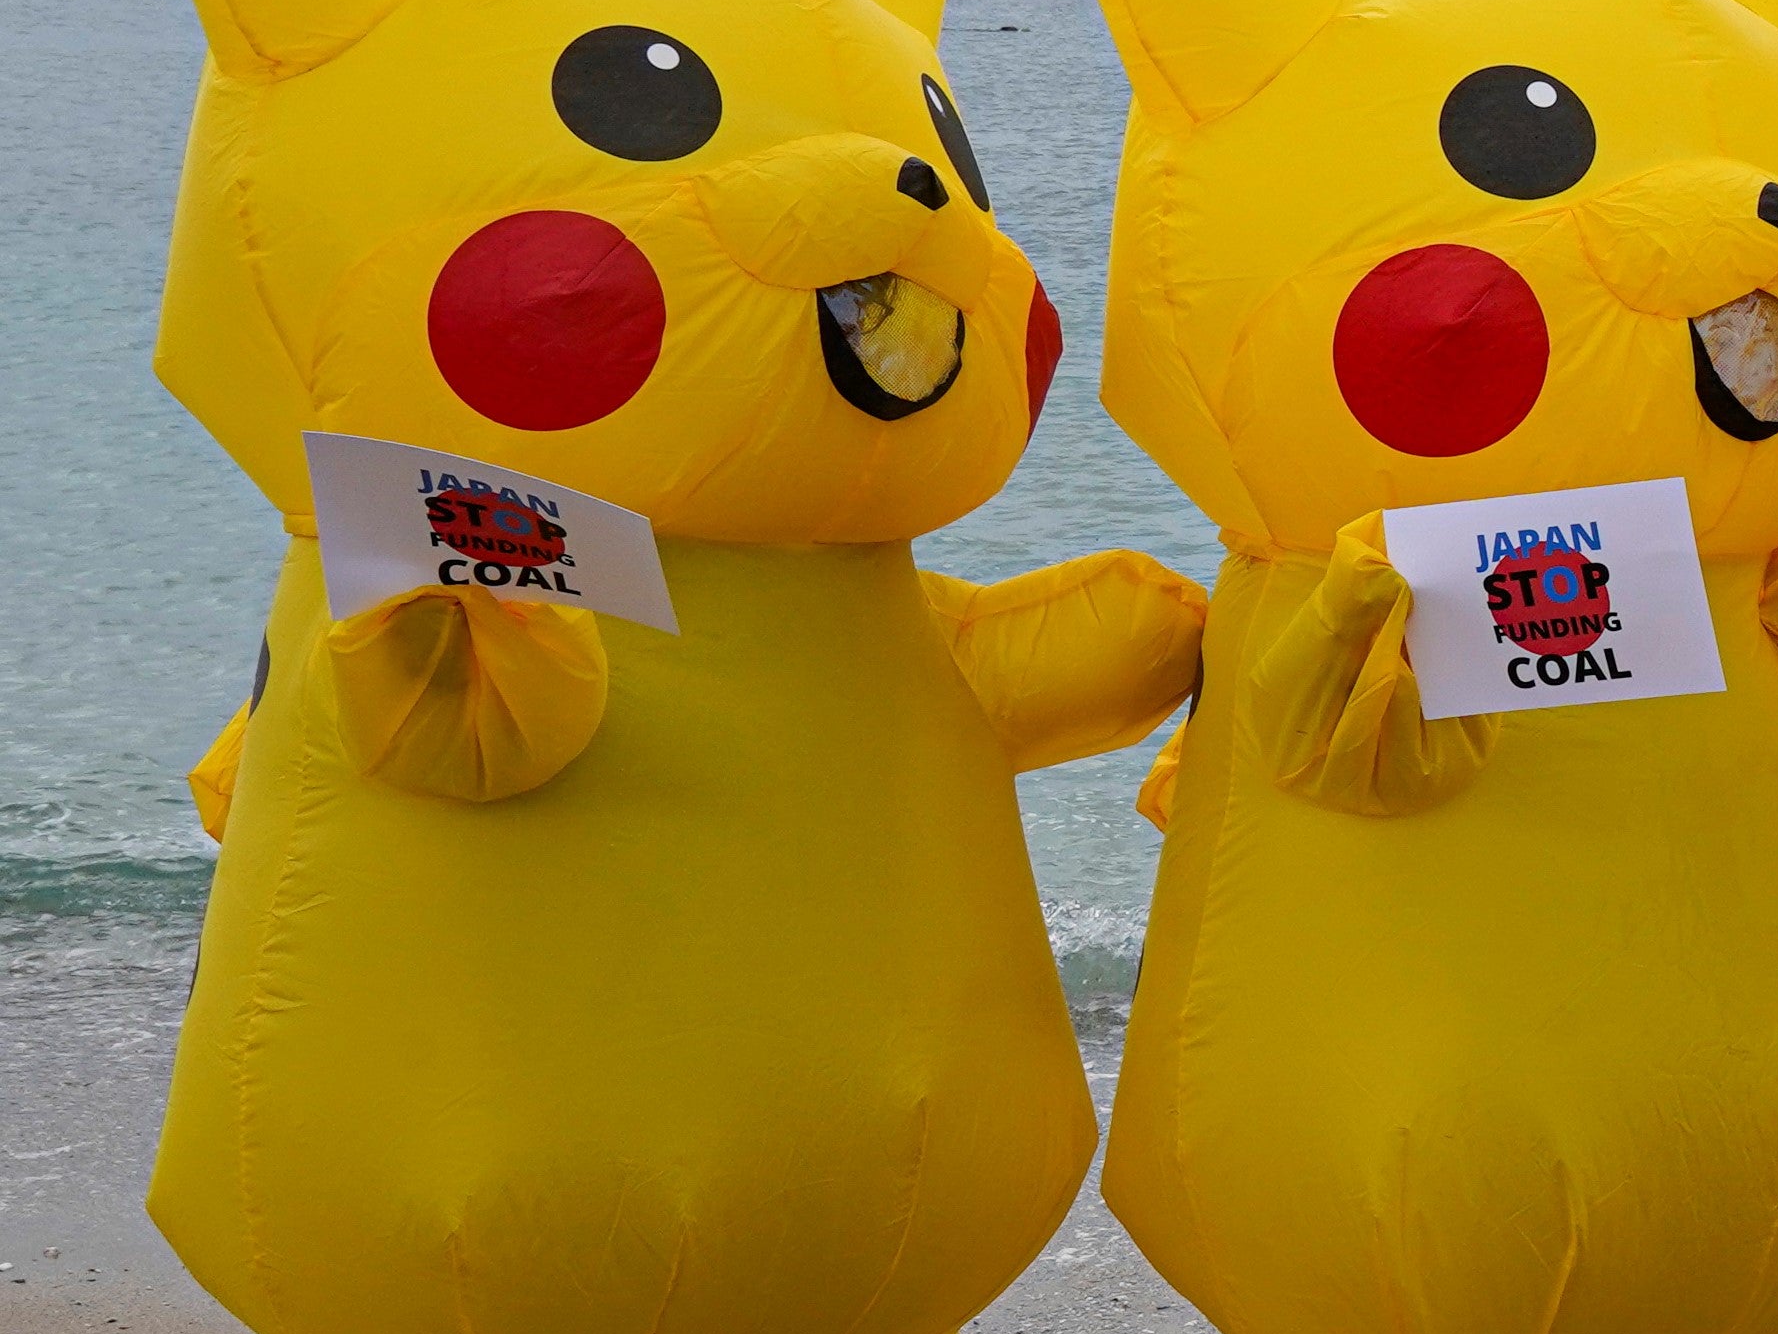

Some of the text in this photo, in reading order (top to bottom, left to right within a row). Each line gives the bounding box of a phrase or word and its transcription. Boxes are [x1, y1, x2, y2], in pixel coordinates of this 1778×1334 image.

[417, 468, 560, 518] JAPAN
[424, 497, 567, 541] STOP
[430, 532, 576, 567] FUNDING
[1476, 521, 1602, 573] JAPAN
[438, 560, 581, 595] COAL
[1483, 562, 1610, 611] STOP
[1493, 612, 1622, 643] FUNDING
[1507, 648, 1632, 689] COAL
